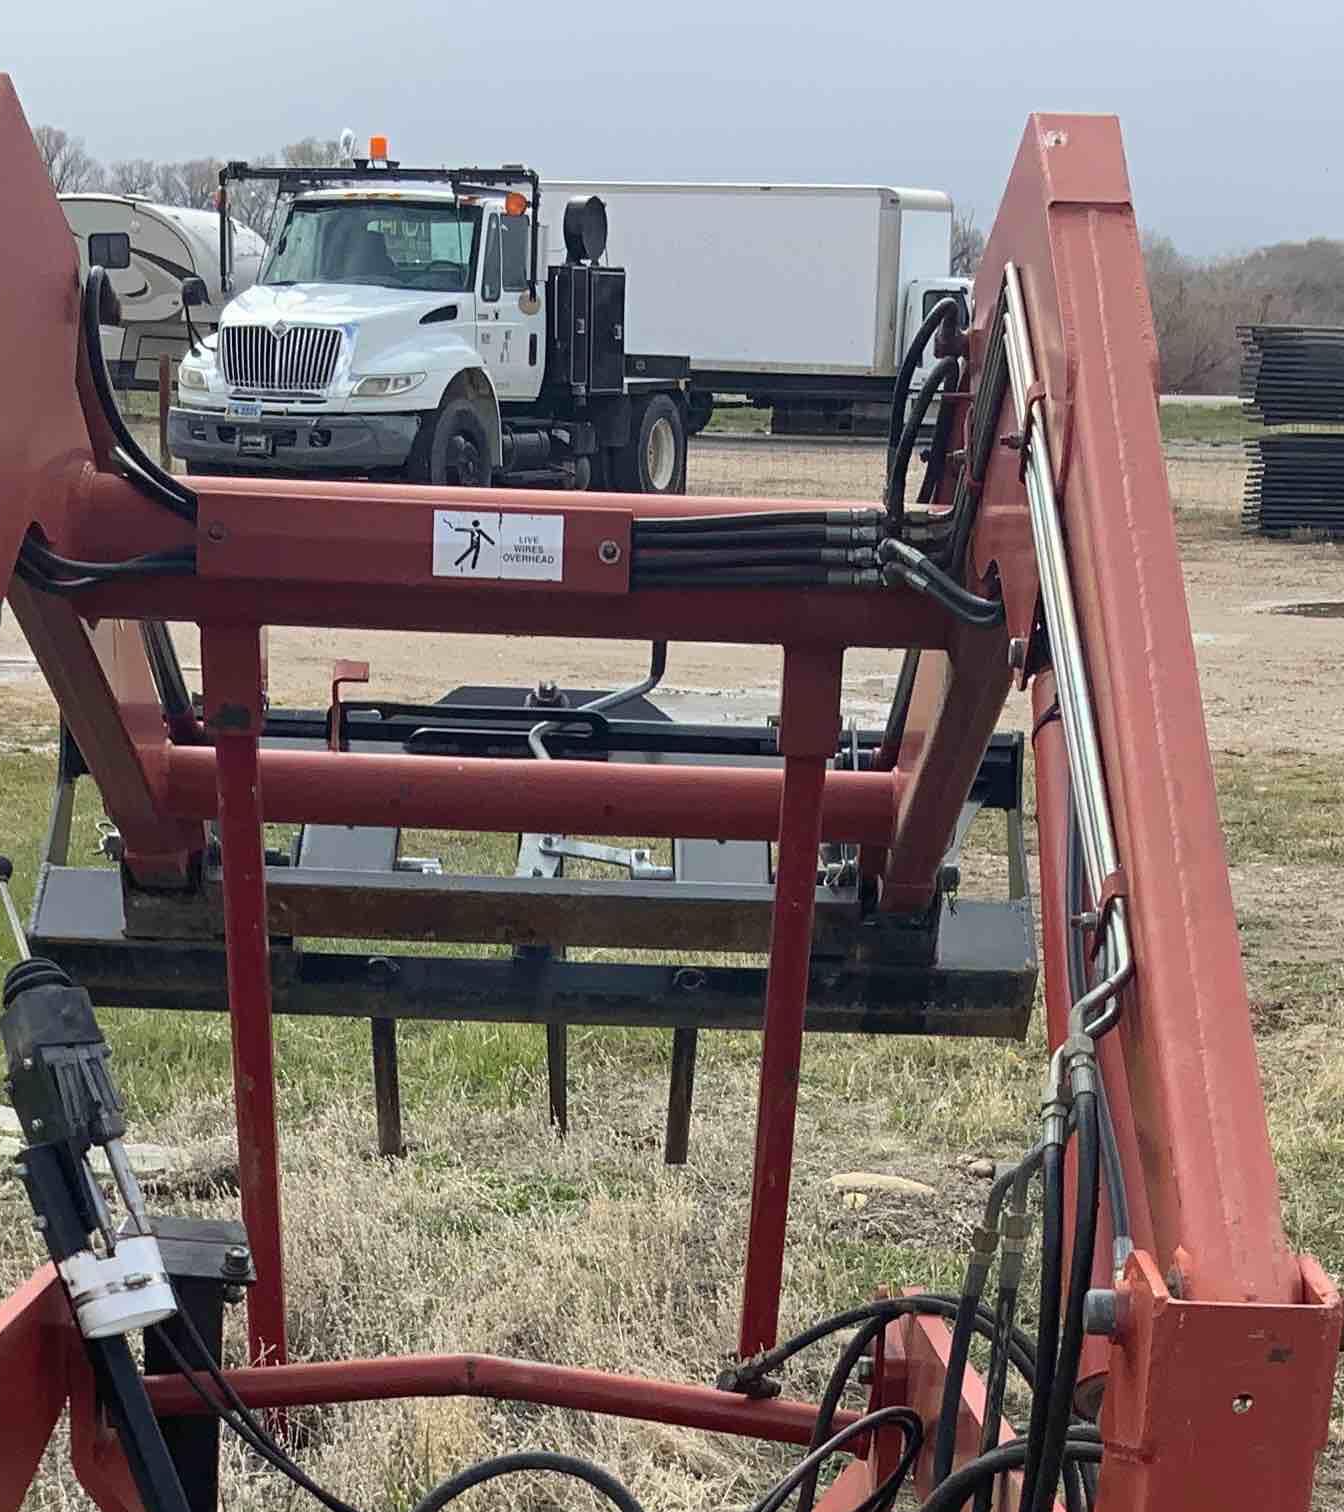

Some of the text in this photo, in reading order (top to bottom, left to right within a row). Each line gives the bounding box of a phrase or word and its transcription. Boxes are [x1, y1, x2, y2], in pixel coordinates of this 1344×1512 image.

[518, 535, 539, 544] LIVE
[513, 543, 544, 554] WIRES
[502, 553, 554, 565] OVERHEAD
